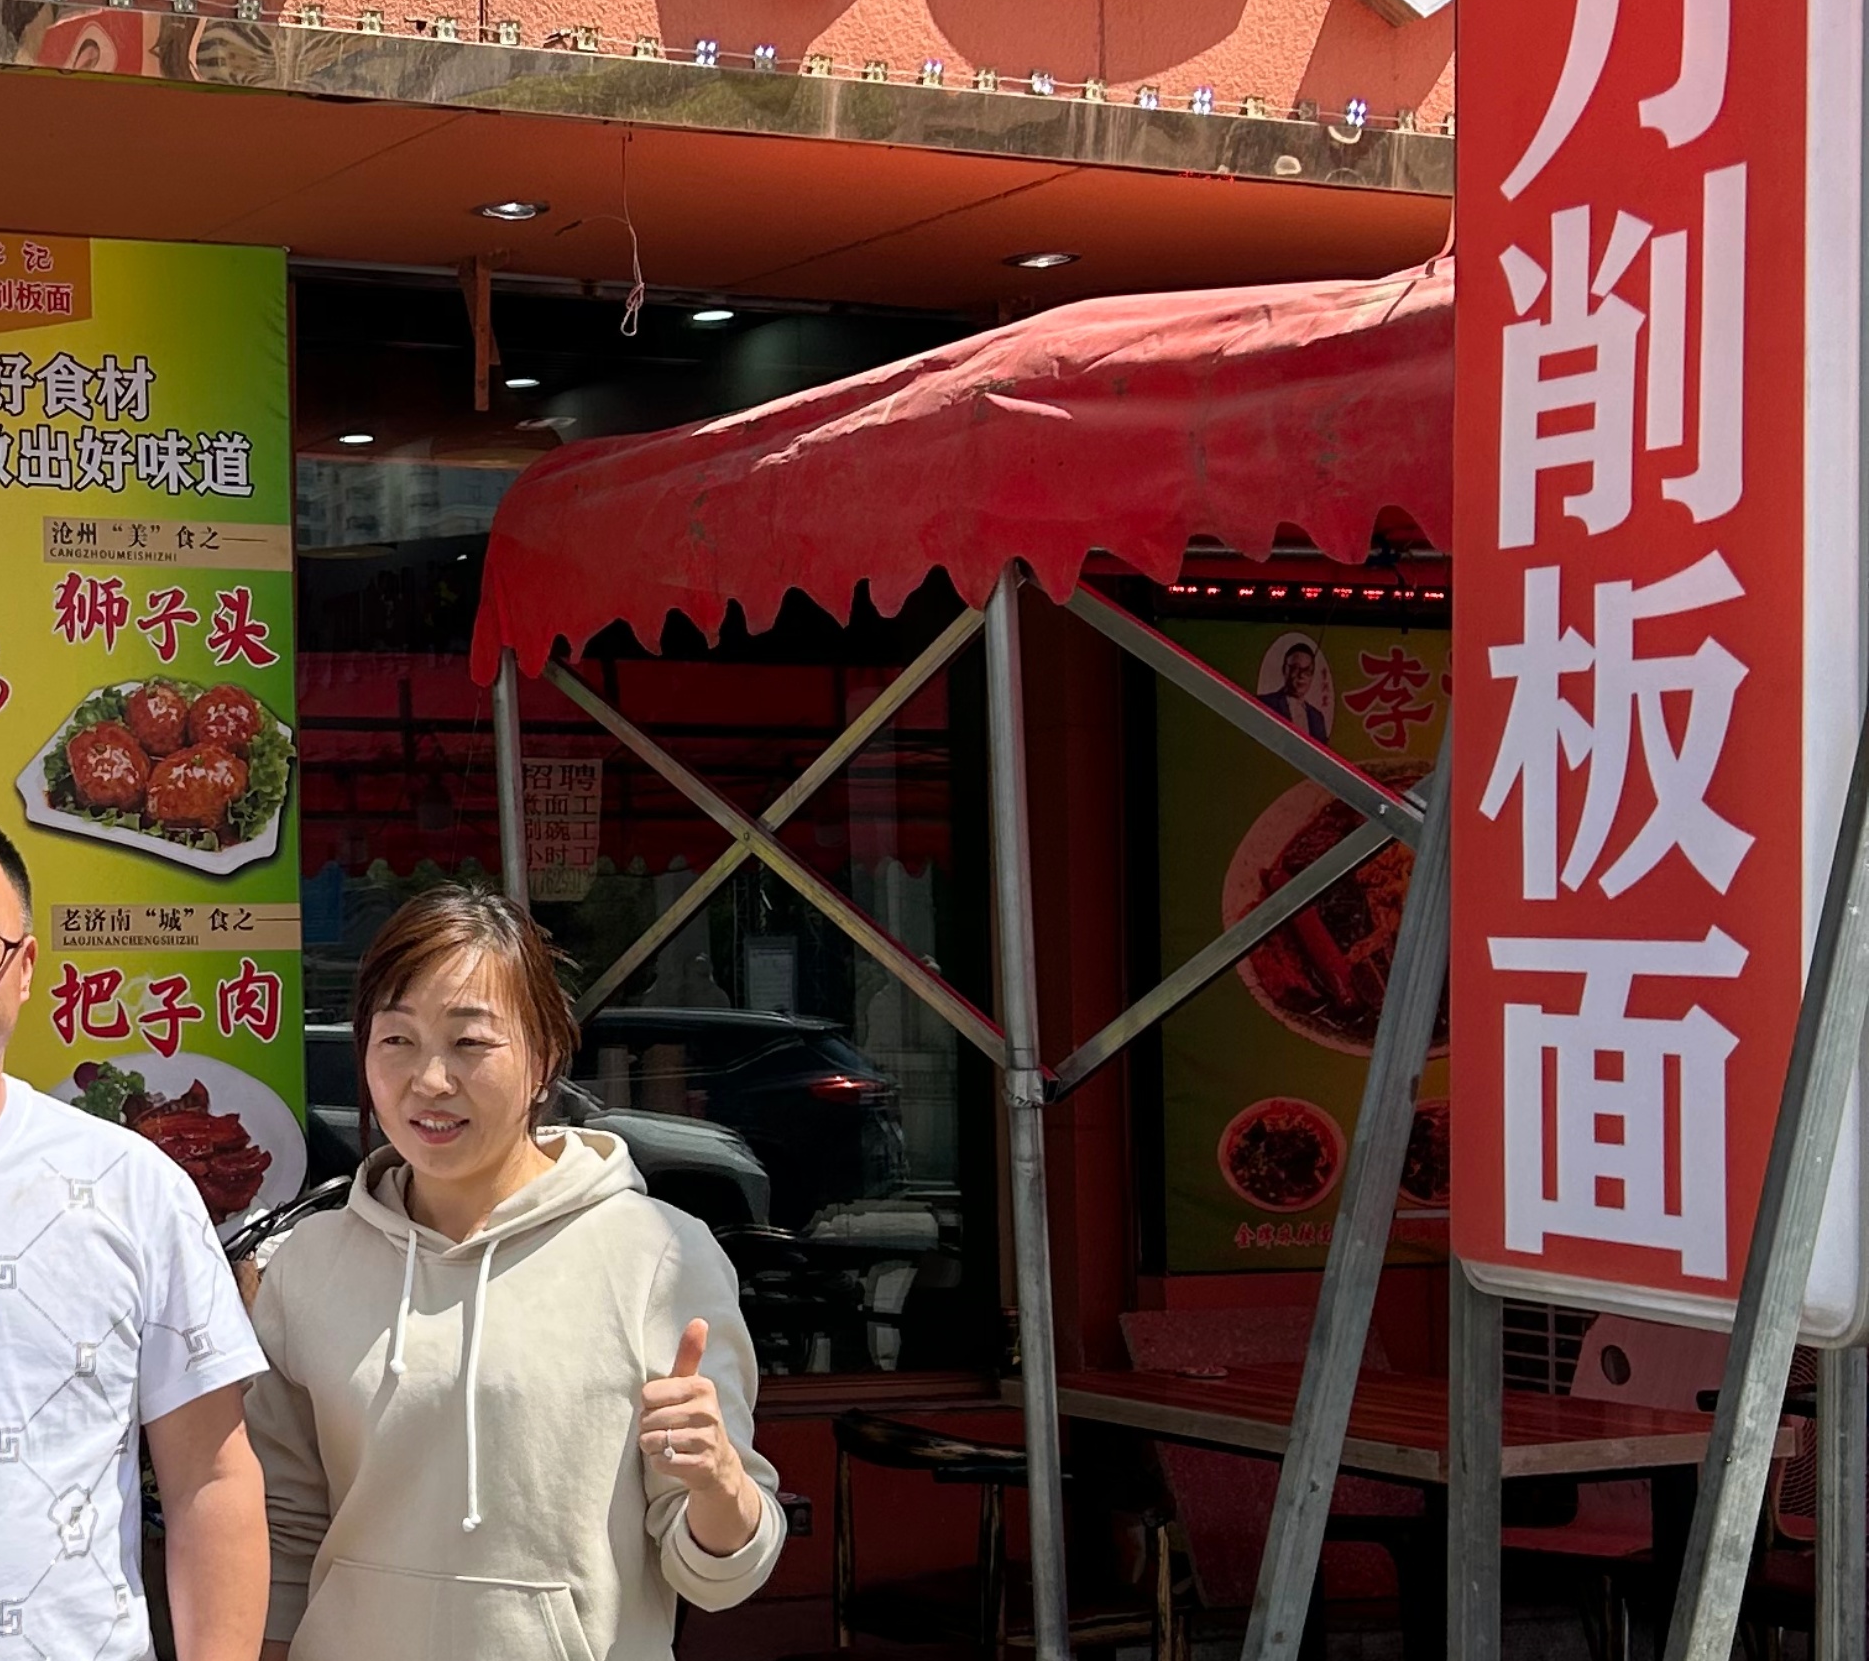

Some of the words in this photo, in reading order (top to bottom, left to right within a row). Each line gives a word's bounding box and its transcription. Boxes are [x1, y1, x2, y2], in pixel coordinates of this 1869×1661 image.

[50, 548, 177, 562] CANGZHOUMEISHIZHI
[54, 572, 280, 666] 狮子头
[1342, 647, 1452, 750] 李
[523, 764, 596, 791] 招聘
[63, 935, 199, 946] LAOJINANCHENGSHIZHI
[50, 957, 283, 1057] 把子肉
